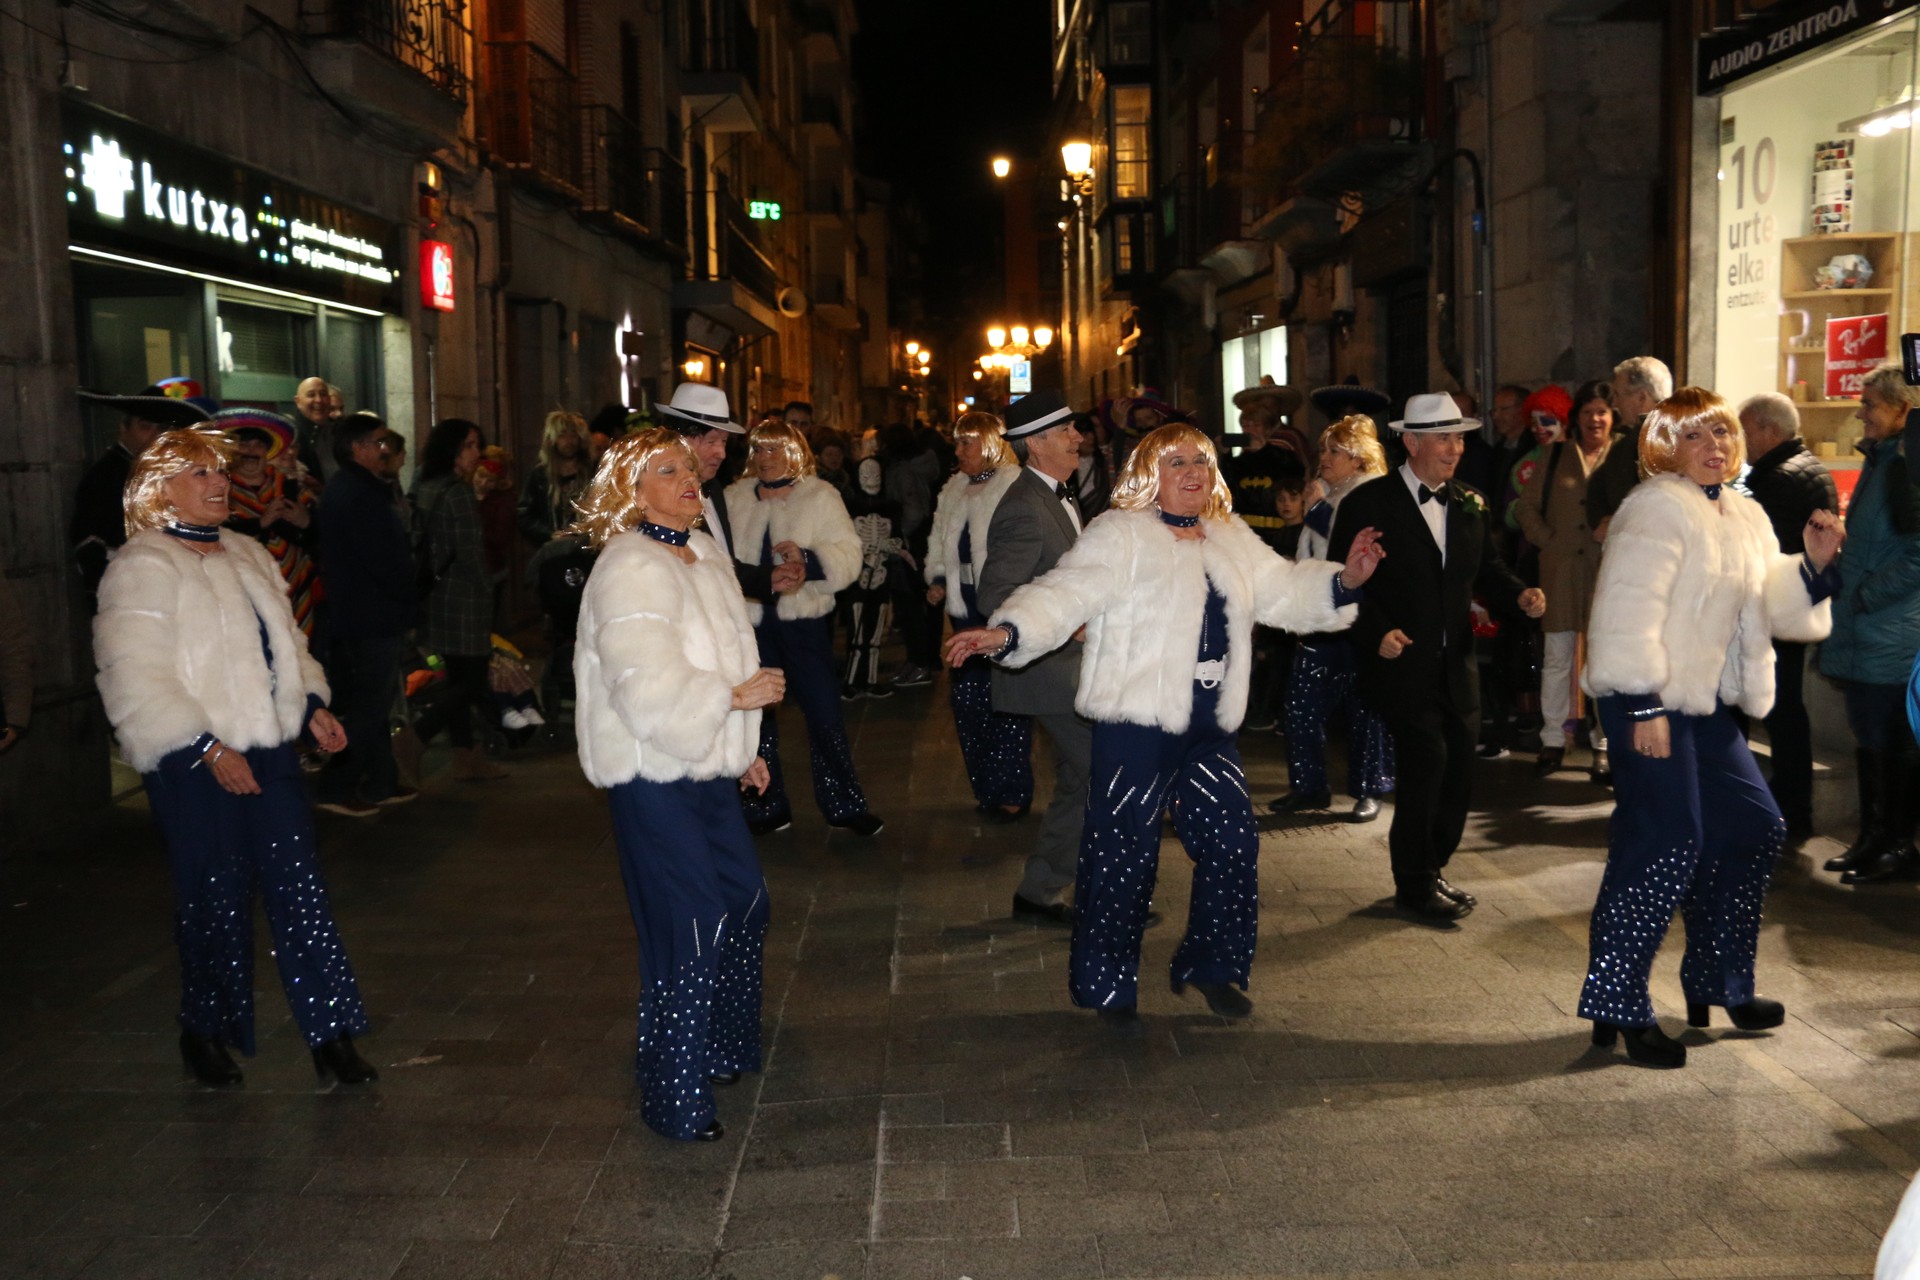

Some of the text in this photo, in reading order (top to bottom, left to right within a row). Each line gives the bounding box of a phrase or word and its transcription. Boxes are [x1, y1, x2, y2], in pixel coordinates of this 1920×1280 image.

[1708, 0, 1858, 80] AUDIO ZENTROA
[141, 161, 249, 243] kutxa
[1731, 136, 1776, 210] 10
[1728, 211, 1775, 250] urte
